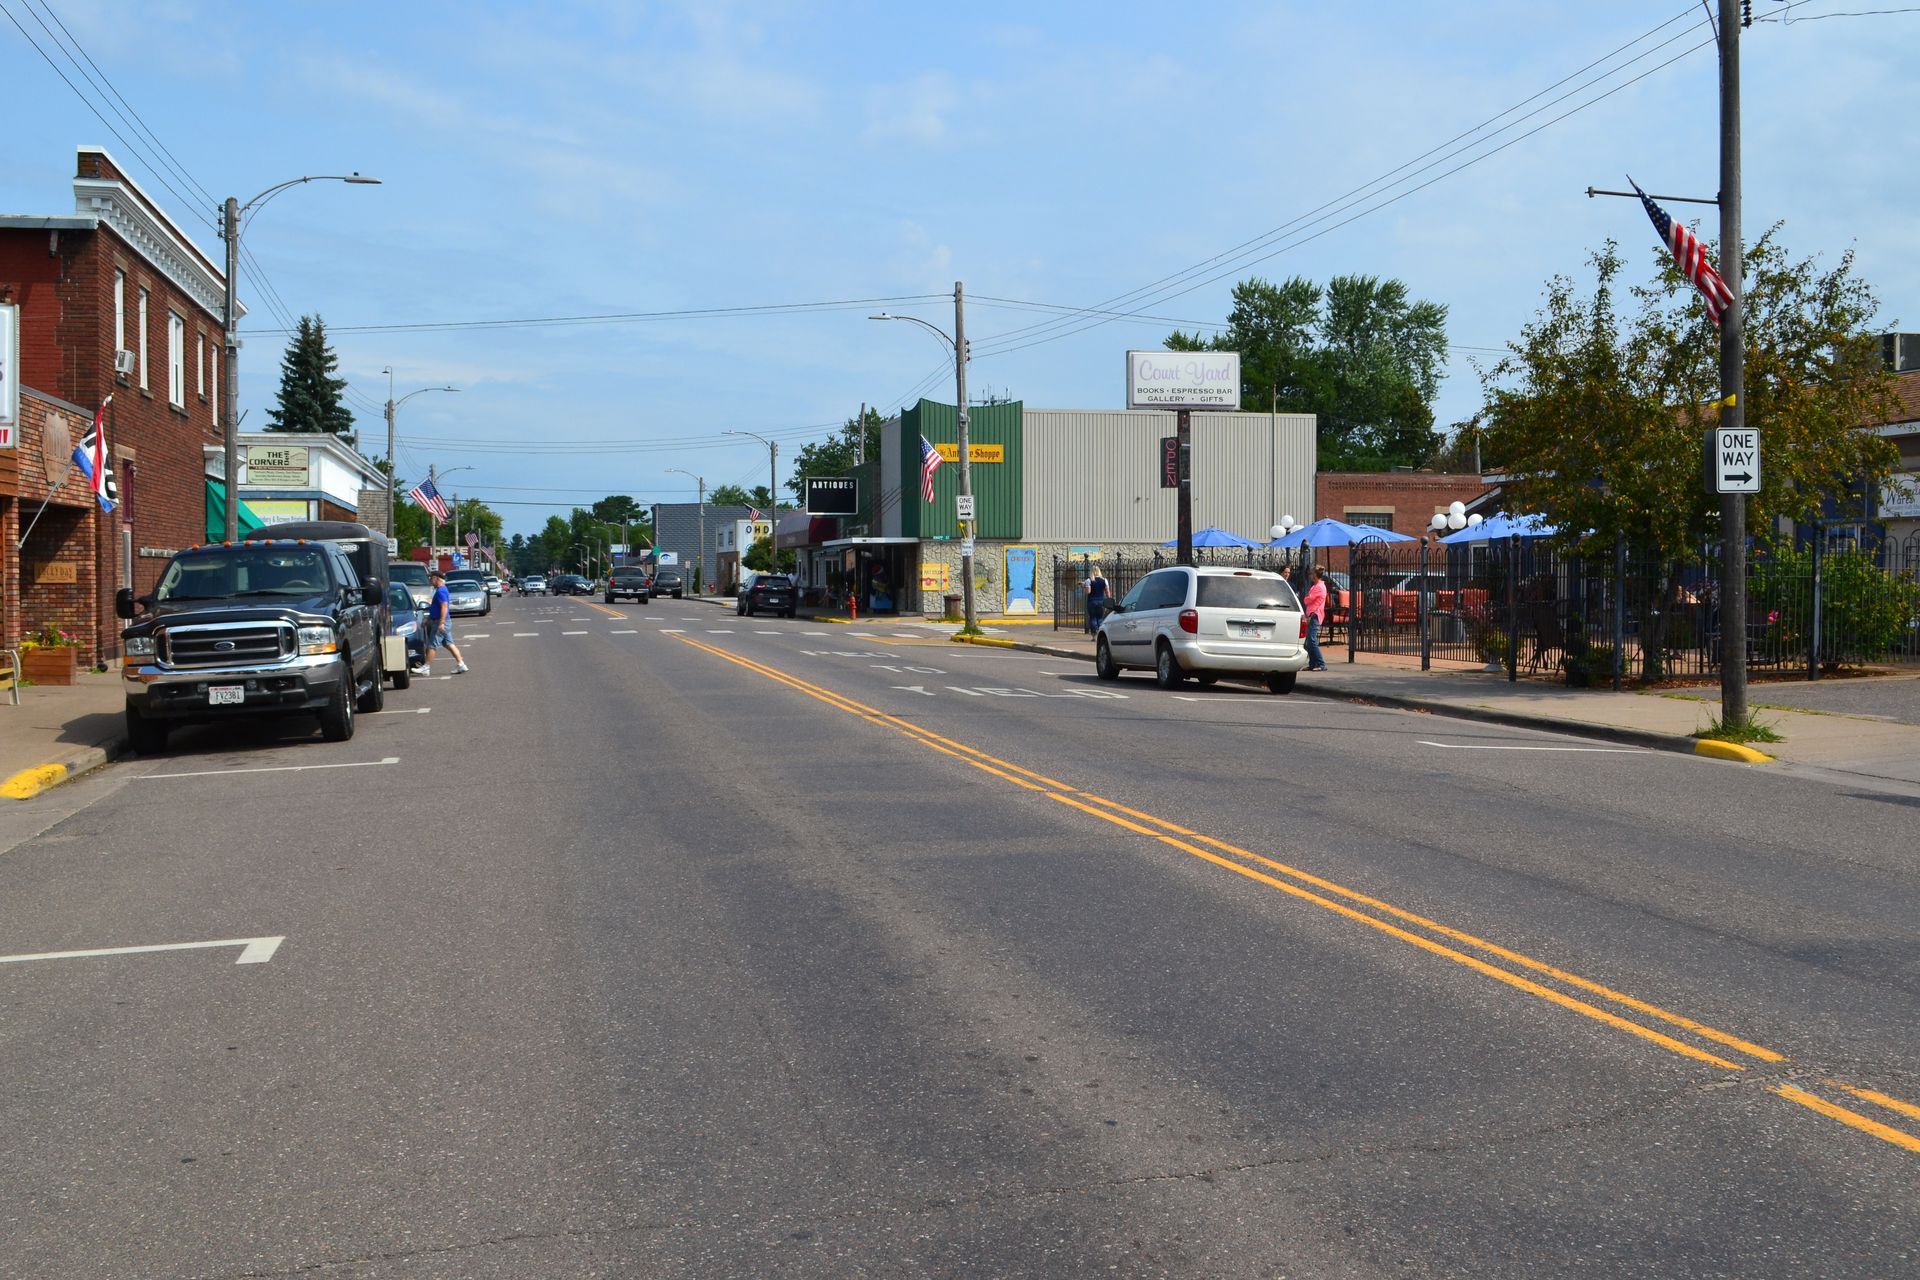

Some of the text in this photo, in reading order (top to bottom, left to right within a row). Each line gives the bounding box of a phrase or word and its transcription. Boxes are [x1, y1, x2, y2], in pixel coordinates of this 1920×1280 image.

[1139, 360, 1231, 386] Court Yard
[1171, 387, 1215, 395] ESPRESSO
[1722, 434, 1754, 449] ONE
[249, 458, 284, 466] CORNER
[267, 451, 283, 459] THE
[1722, 451, 1754, 466] WAY
[1165, 439, 1177, 486] OPEN
[811, 481, 855, 489] ANTIQUES
[889, 685, 1131, 699] YIELD
